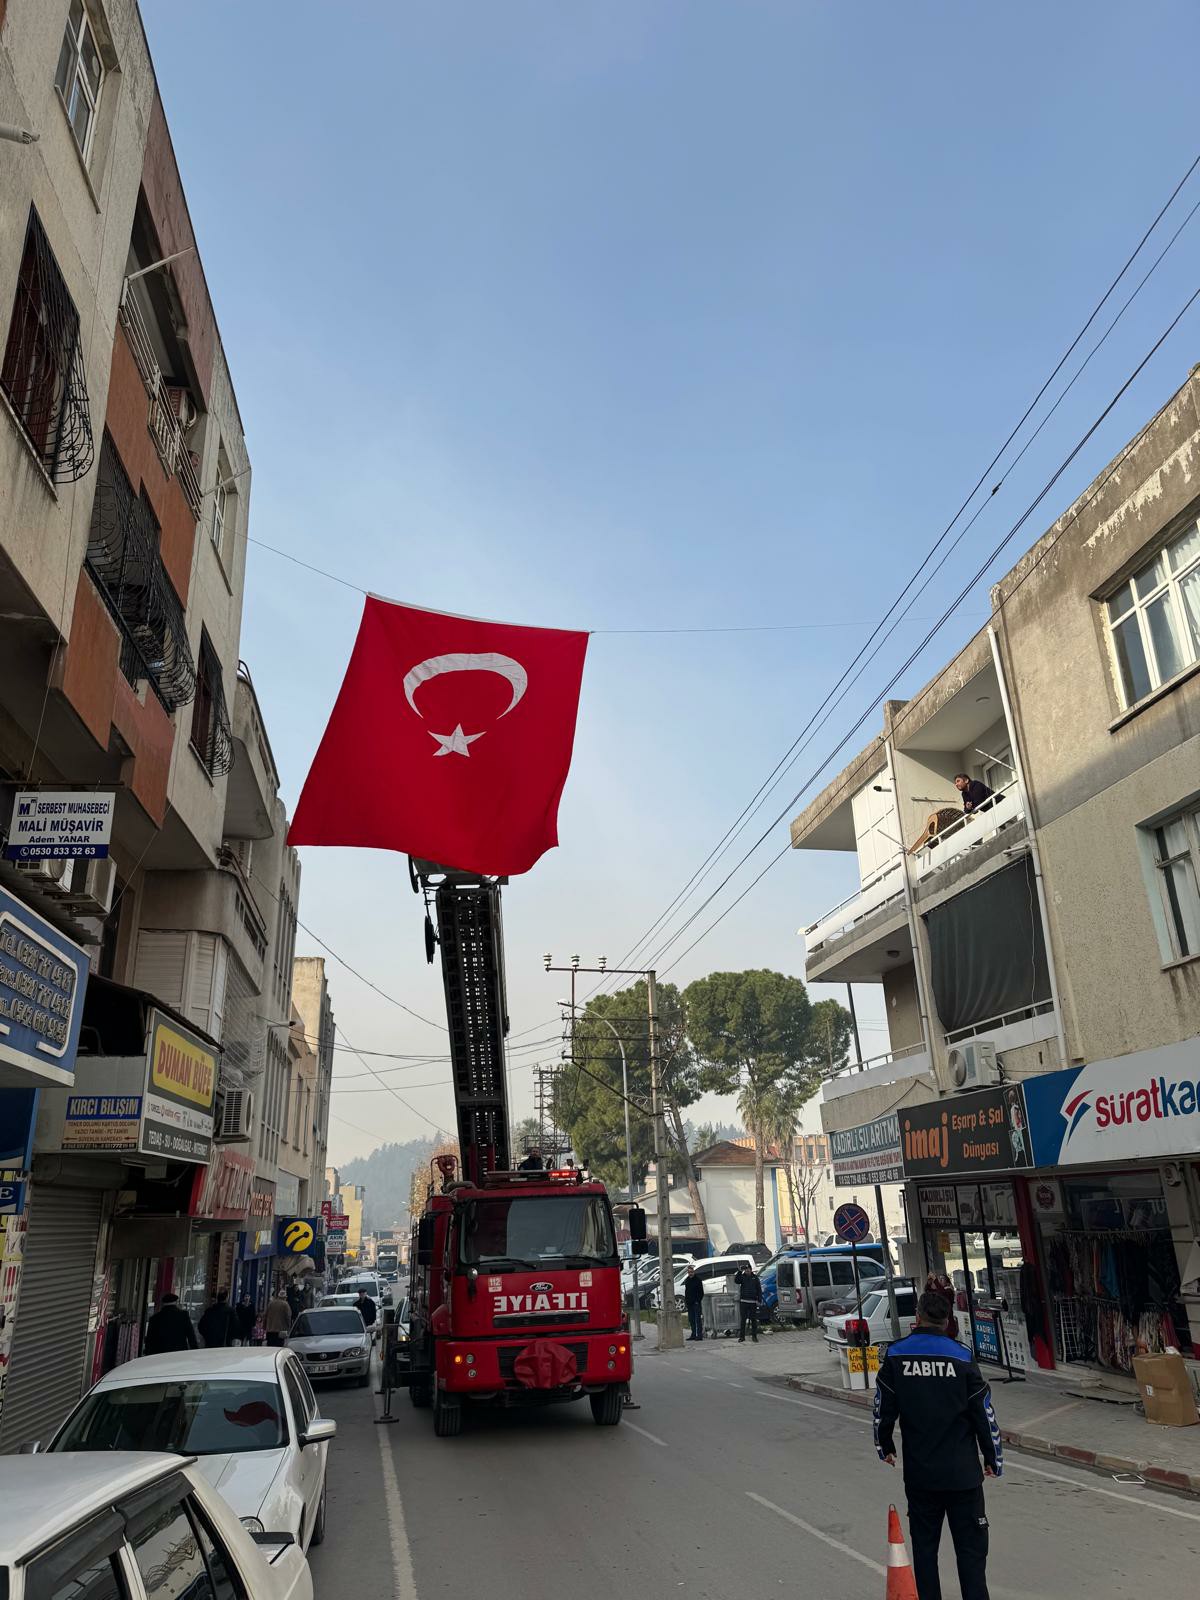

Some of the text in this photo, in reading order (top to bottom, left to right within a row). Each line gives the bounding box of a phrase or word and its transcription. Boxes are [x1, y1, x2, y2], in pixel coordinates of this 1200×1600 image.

[37, 801, 110, 814] SERBEST MUHASEBECİ
[18, 818, 104, 834] MALİ MÜŞAVİR
[58, 835, 90, 843] YANAR
[30, 847, 96, 855] 0530 833 32 63
[158, 1040, 212, 1096] DUMAN BÜFE
[70, 1098, 98, 1115] KIRCI
[859, 1127, 869, 1150] SU
[904, 1112, 949, 1168] imaj
[952, 1112, 976, 1133] Eşarp
[979, 1110, 986, 1126] &
[988, 1105, 1004, 1128] Şal
[963, 1141, 999, 1160] Dünyası
[490, 1278, 500, 1286] 112
[902, 1361, 957, 1377] ZABITA
